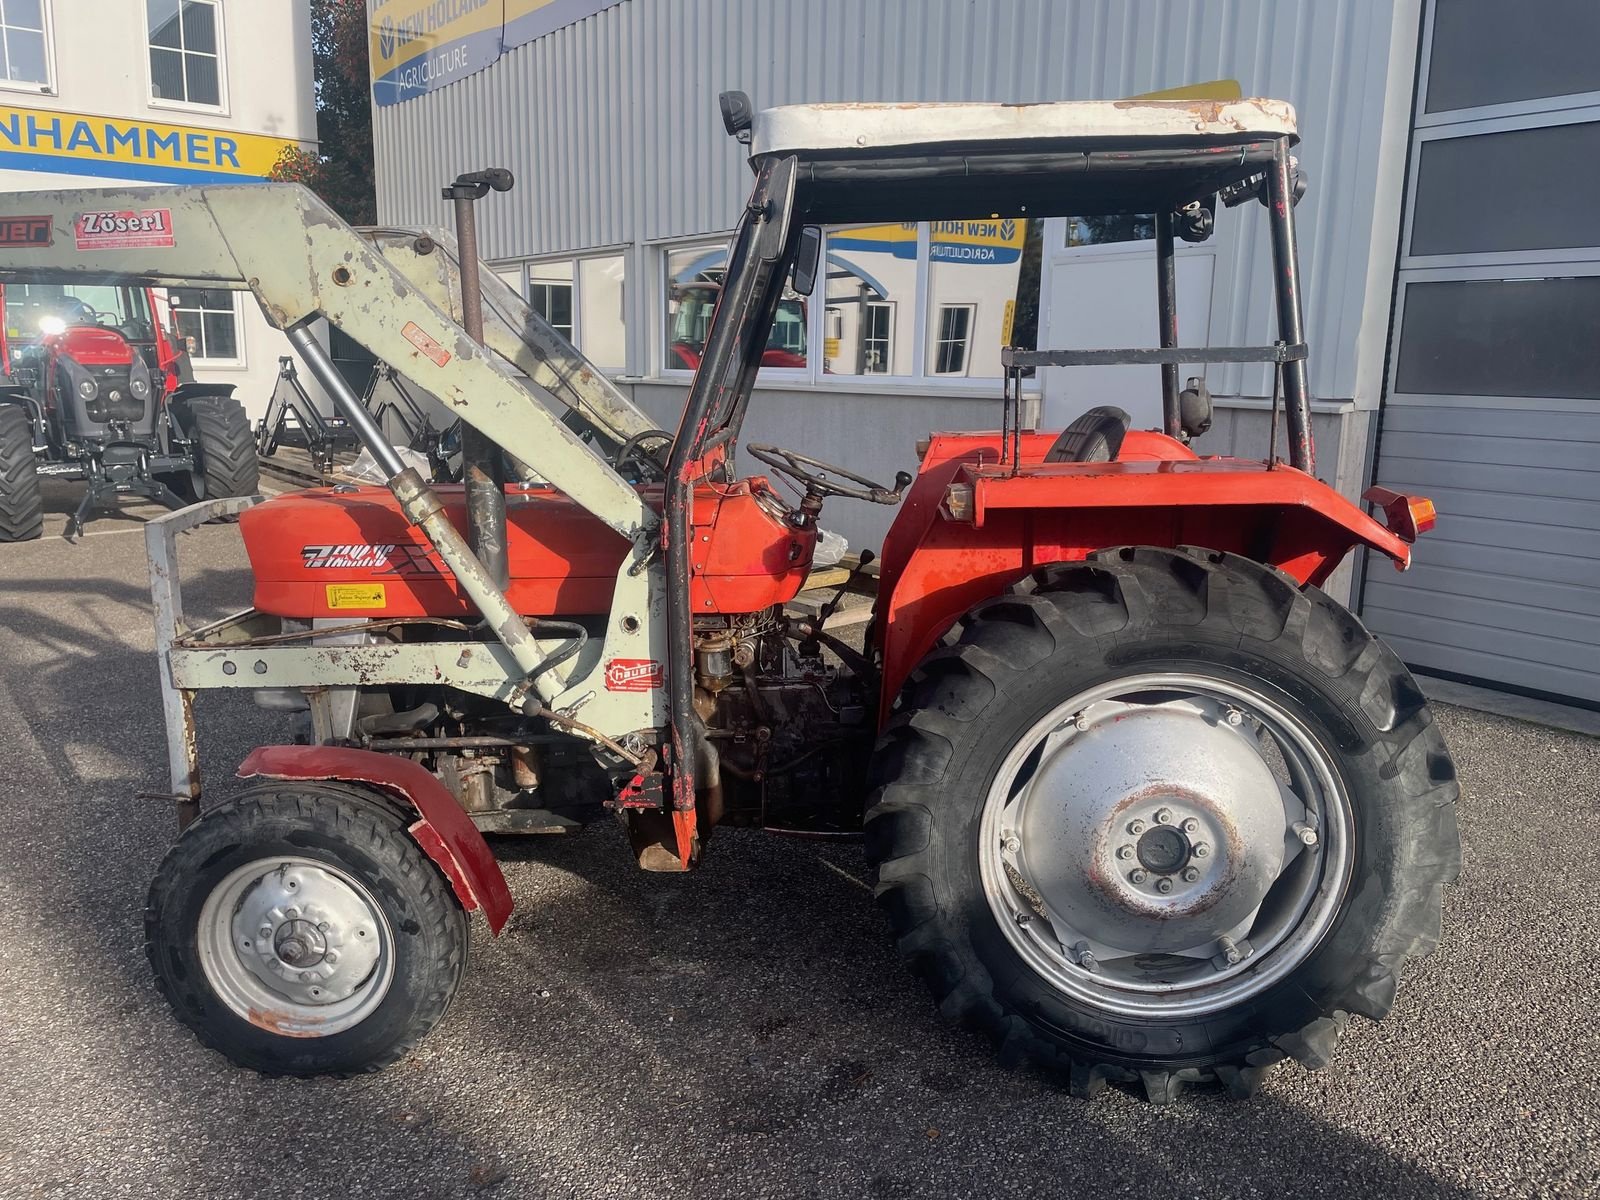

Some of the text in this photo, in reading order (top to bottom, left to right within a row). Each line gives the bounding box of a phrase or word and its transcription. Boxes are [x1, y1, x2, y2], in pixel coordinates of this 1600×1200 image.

[397, 0, 488, 47] NEW HOLLA
[399, 44, 468, 92] AGRICULTURE
[82, 211, 165, 233] Zöserl
[615, 664, 657, 681] hauer
